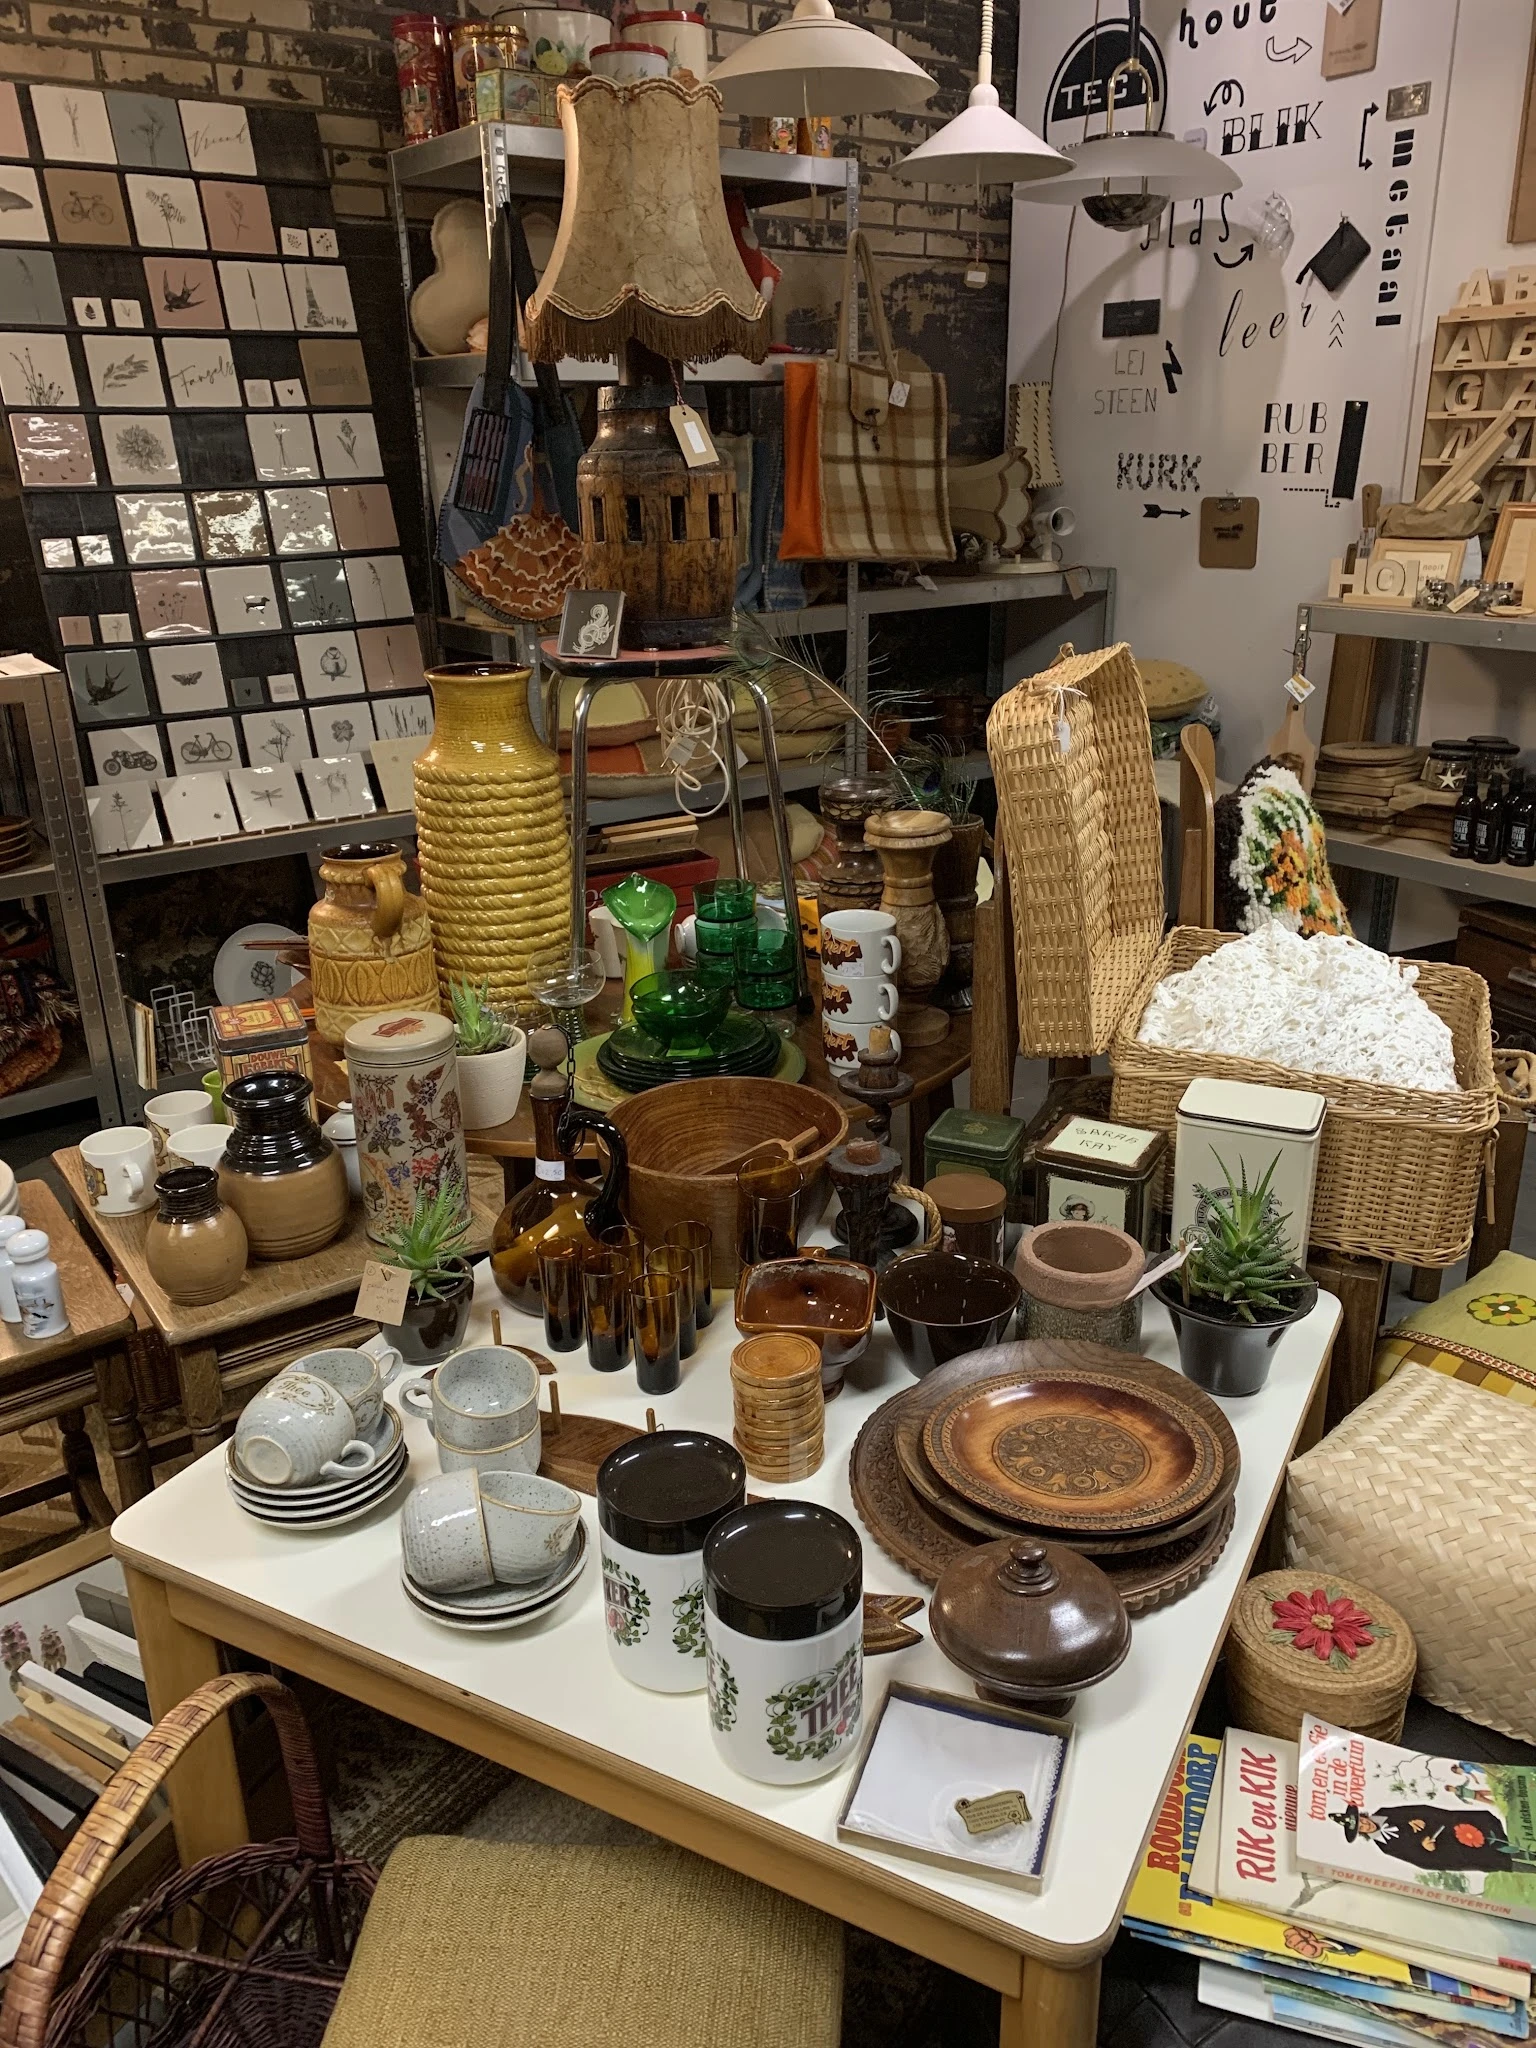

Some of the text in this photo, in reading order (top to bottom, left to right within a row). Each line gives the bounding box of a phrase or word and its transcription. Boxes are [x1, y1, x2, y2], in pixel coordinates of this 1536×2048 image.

[1179, 0, 1276, 48] hout
[1221, 101, 1323, 155] BLIK
[1219, 288, 1317, 357] leer
[1115, 349, 1145, 375] LEI
[1094, 387, 1157, 414] STEEN
[1264, 402, 1328, 434] RUB
[1117, 452, 1201, 492] KURK
[1261, 442, 1324, 474] BER
[249, 1050, 286, 1061] DOUWE
[279, 1381, 311, 1398] Thee
[1239, 1747, 1278, 1800] KIK
[1147, 1748, 1186, 1874] ROODD
[1179, 1743, 1218, 1906] BUWDORP
[1251, 1800, 1277, 1831] en
[1236, 1828, 1277, 1883] RIK
[1330, 1868, 1355, 1880] TOM
[1356, 1874, 1371, 1885] EN
[1373, 1878, 1409, 1894] EEFJE
[1411, 1886, 1424, 1896] IN
[1426, 1890, 1441, 1900] DE
[1445, 1894, 1511, 1915] TOVERTUIN
